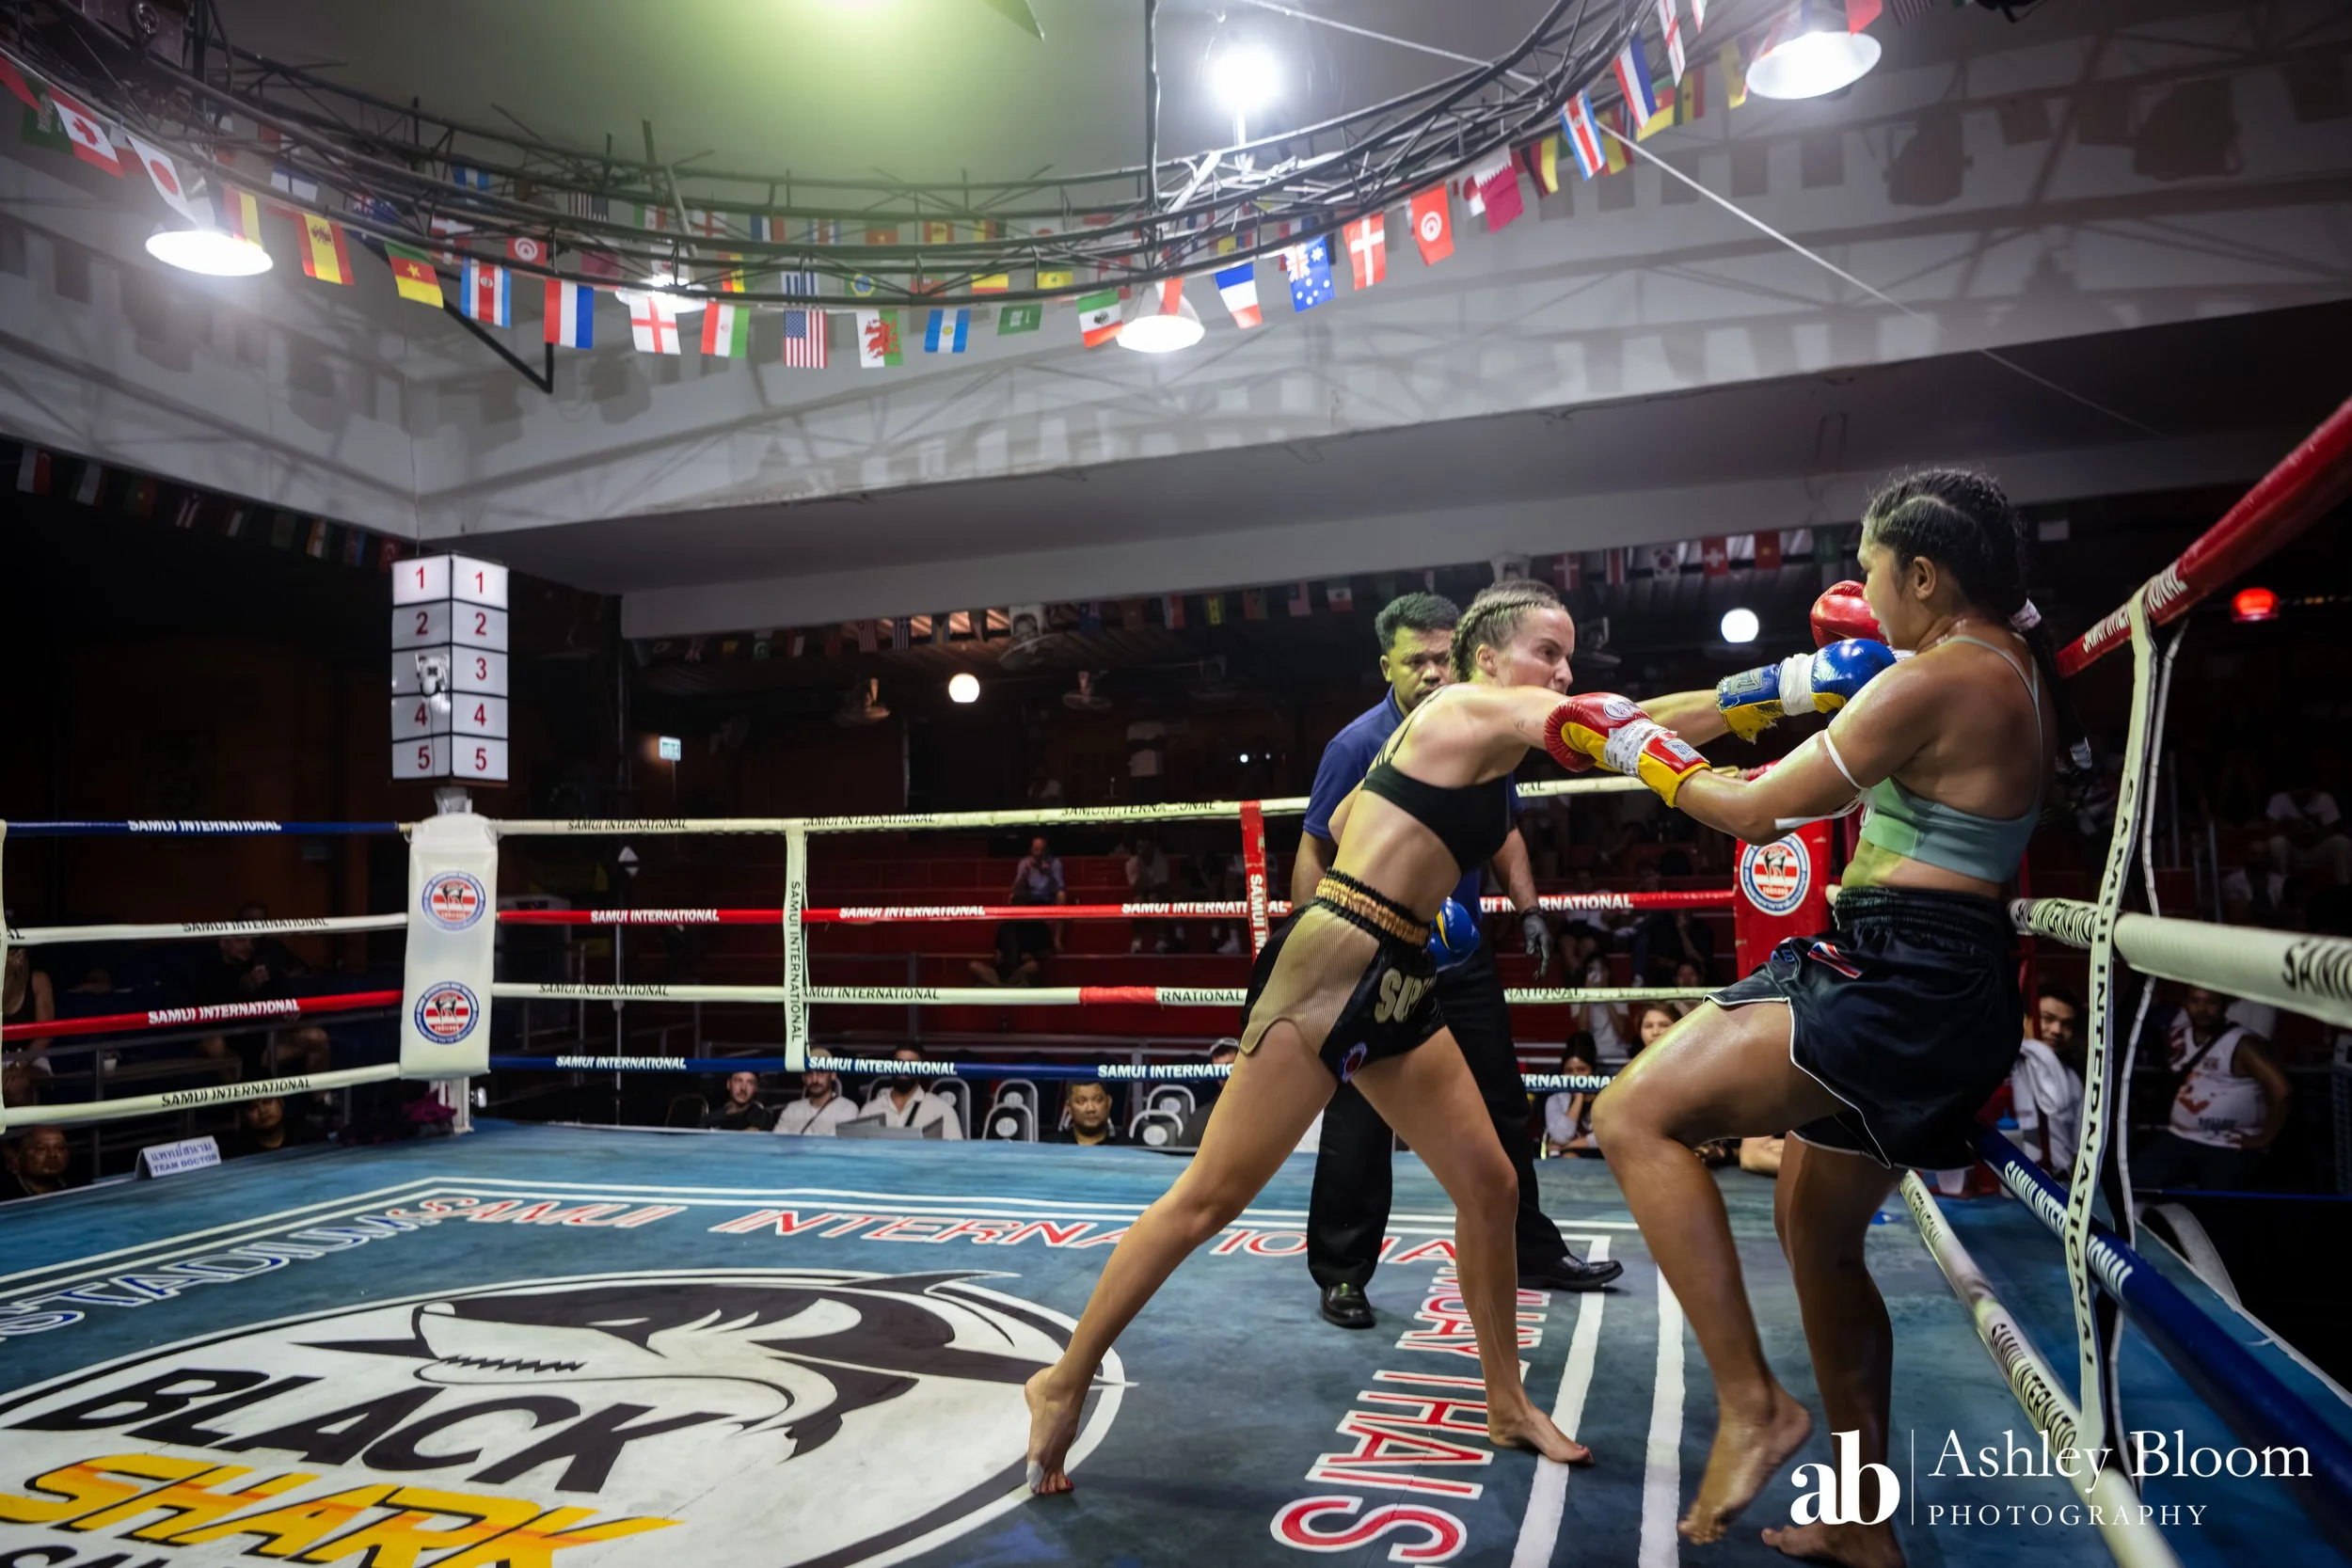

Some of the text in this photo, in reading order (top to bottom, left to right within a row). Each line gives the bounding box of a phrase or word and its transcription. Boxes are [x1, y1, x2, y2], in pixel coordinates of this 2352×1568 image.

[415, 566, 424, 590] 1
[474, 571, 484, 594] 1
[416, 611, 429, 636] 2
[474, 612, 487, 636] 2
[475, 657, 487, 680] 3
[414, 703, 428, 726] 4
[473, 704, 486, 726] 4
[417, 746, 430, 769] 5
[474, 748, 487, 770] 5
[838, 905, 986, 918] SAMUI INTERNATIONAL
[1121, 900, 1288, 913] SAMUI INTERNATIAL
[1248, 874, 1265, 927] SAMUI
[1502, 894, 1634, 911] INRNATIONAL
[591, 909, 720, 923] SAMUI INTERNATIONAL
[789, 880, 803, 1043] SAMUI INTERNATIONAL
[838, 988, 940, 1000] INTERNATIONAL
[1162, 990, 1245, 1003] RNATIONAL
[148, 998, 300, 1024] SAMUI INTERNATIONAL
[555, 1055, 687, 1069] SAMUI INTERNATIONAL
[808, 1056, 958, 1075] SAMUI INTERNATIONAL
[1098, 1064, 1147, 1078] SAMUI
[161, 1077, 311, 1107] SAMUI INTERNATIONAL
[154, 1153, 217, 1173] TEAM DOCTOR
[387, 1196, 689, 1227] SAMUI
[3, 1369, 734, 1493] BLACK
[0, 1453, 686, 1568] SHARK
